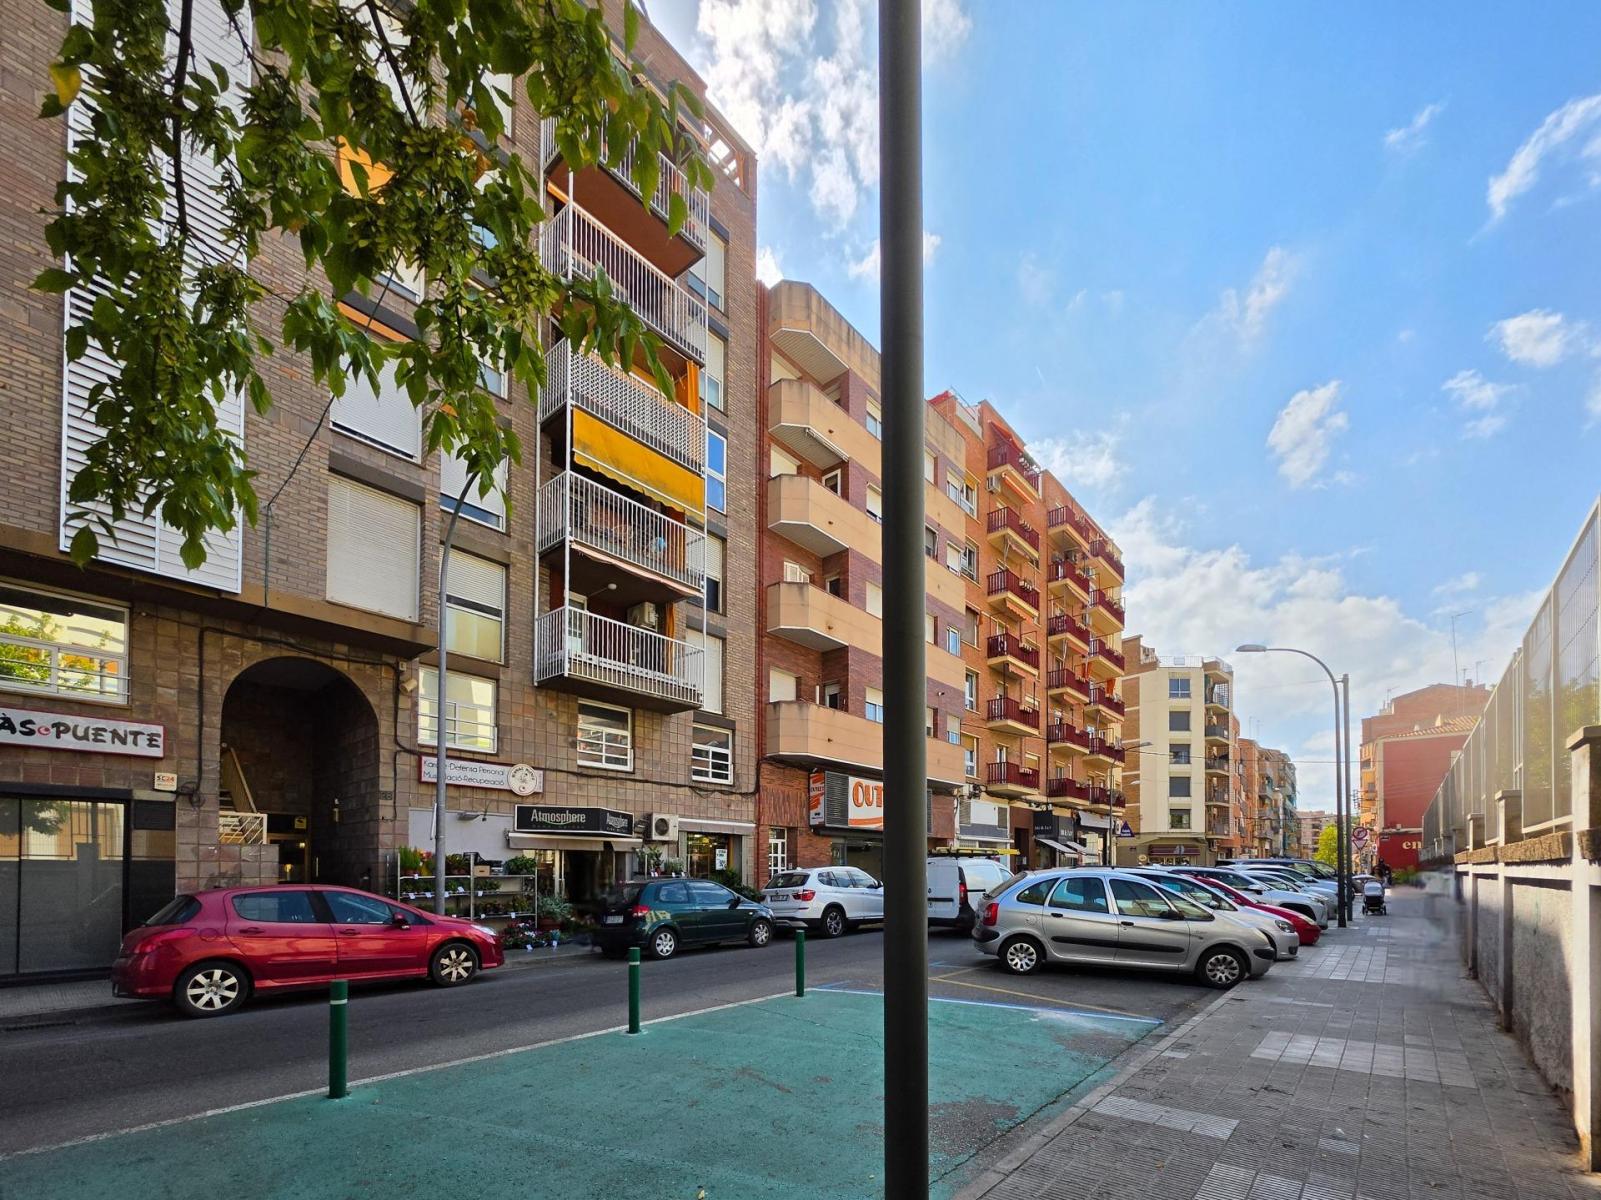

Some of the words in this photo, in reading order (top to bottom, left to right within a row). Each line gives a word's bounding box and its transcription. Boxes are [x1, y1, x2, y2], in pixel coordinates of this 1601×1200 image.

[51, 721, 162, 749] PUENTE
[853, 781, 884, 808] OUT
[530, 808, 586, 825] Atmosphere
